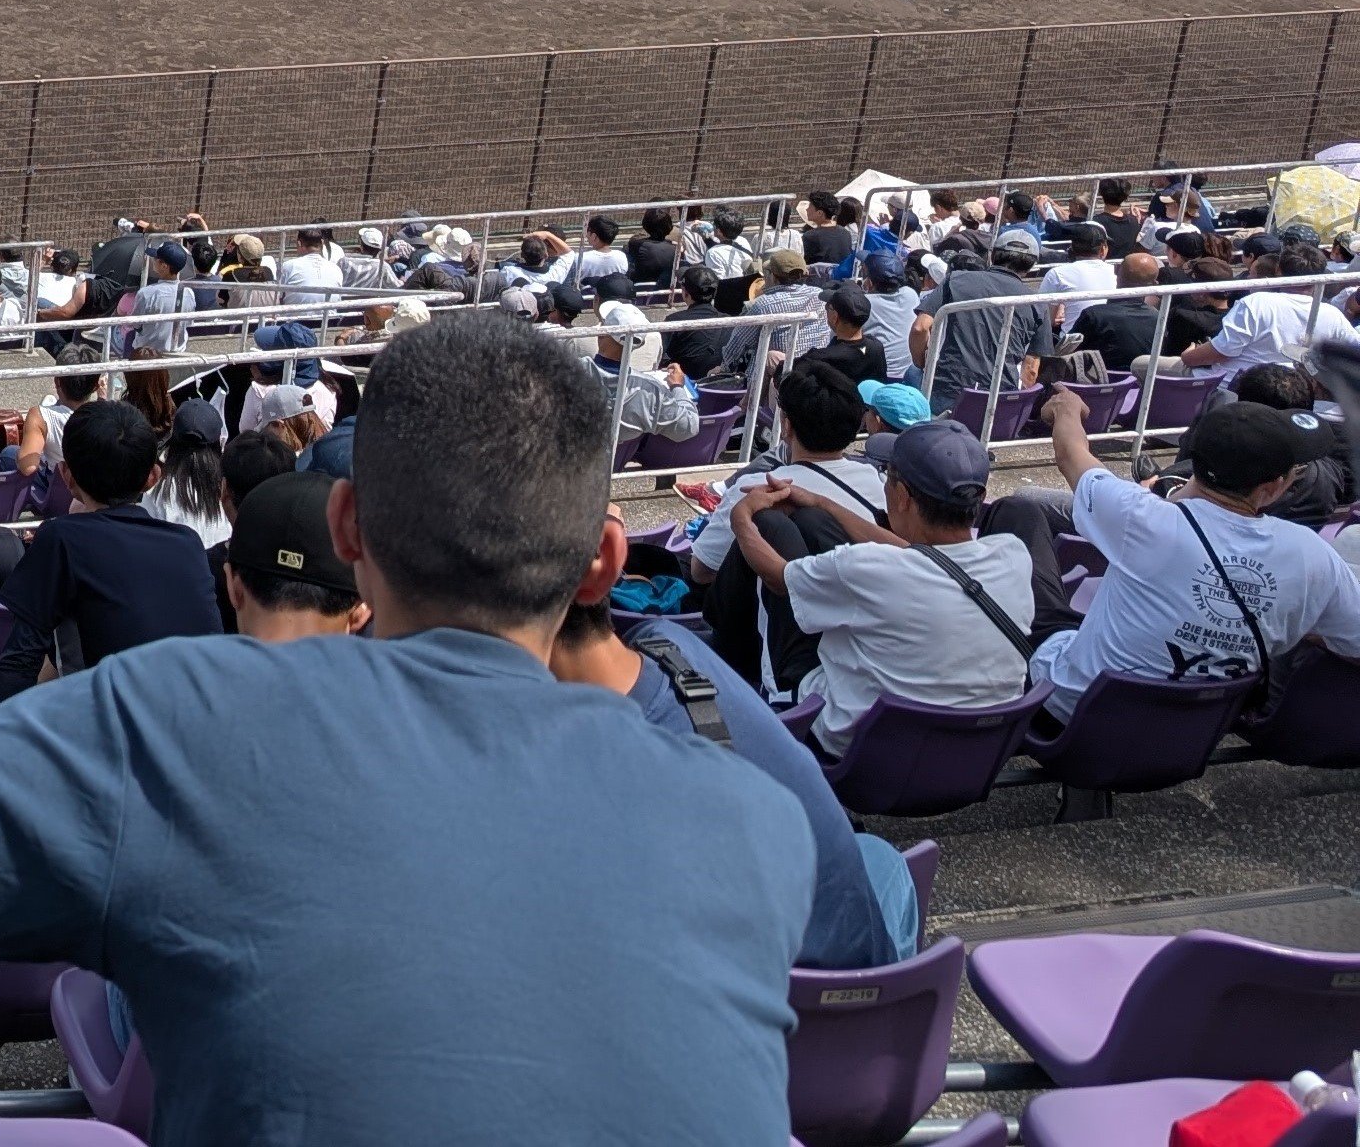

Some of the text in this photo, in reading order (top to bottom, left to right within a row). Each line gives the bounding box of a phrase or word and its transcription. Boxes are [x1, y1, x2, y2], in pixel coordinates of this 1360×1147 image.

[1197, 563, 1211, 576] LA
[1264, 572, 1278, 592] AUX
[1208, 587, 1226, 599] THE
[1192, 584, 1206, 610] WITH
[1206, 610, 1223, 627] THE
[1174, 628, 1199, 643] DEN
[1182, 621, 1202, 634] DIE
[1202, 628, 1240, 643] MARKE
